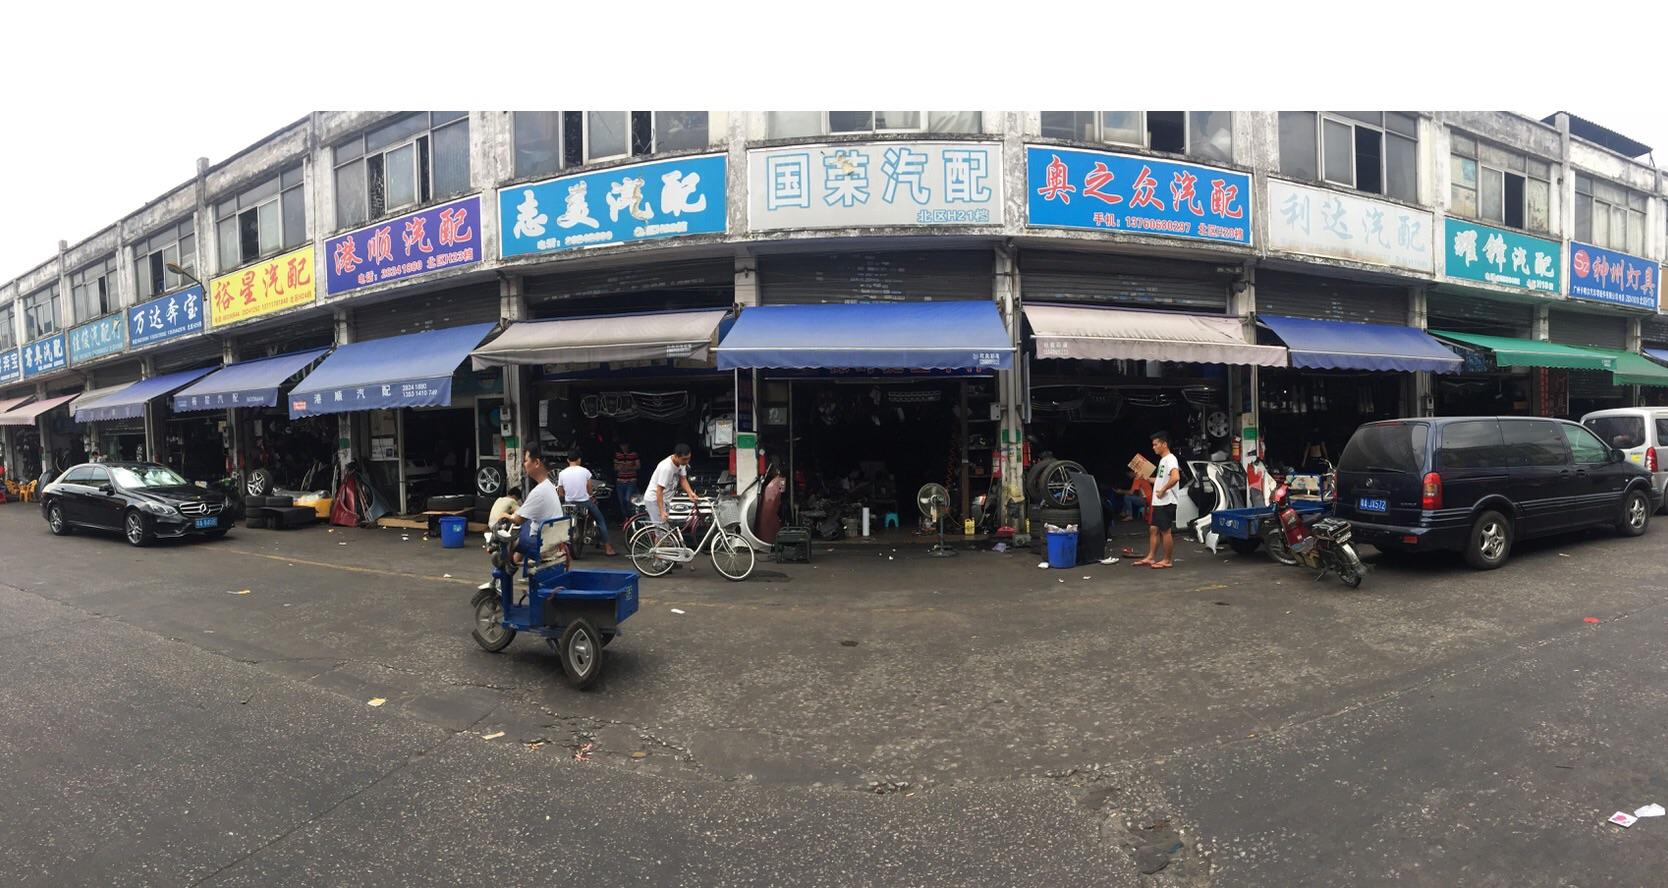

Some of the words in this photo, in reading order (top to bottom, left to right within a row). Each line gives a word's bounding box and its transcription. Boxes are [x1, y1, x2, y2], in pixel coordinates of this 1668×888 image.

[766, 147, 992, 211] 国荣汽配
[1037, 154, 1244, 218] 奥之众汽配
[334, 207, 472, 275] 港顺汽配
[917, 208, 989, 223] 北区H21档
[1280, 193, 1425, 252] 利达汽配
[214, 257, 311, 313] 裕星汽配
[1592, 255, 1656, 297] 神州灯具
[133, 293, 198, 334] 万达奔宝
[0, 352, 19, 373] 奔宝
